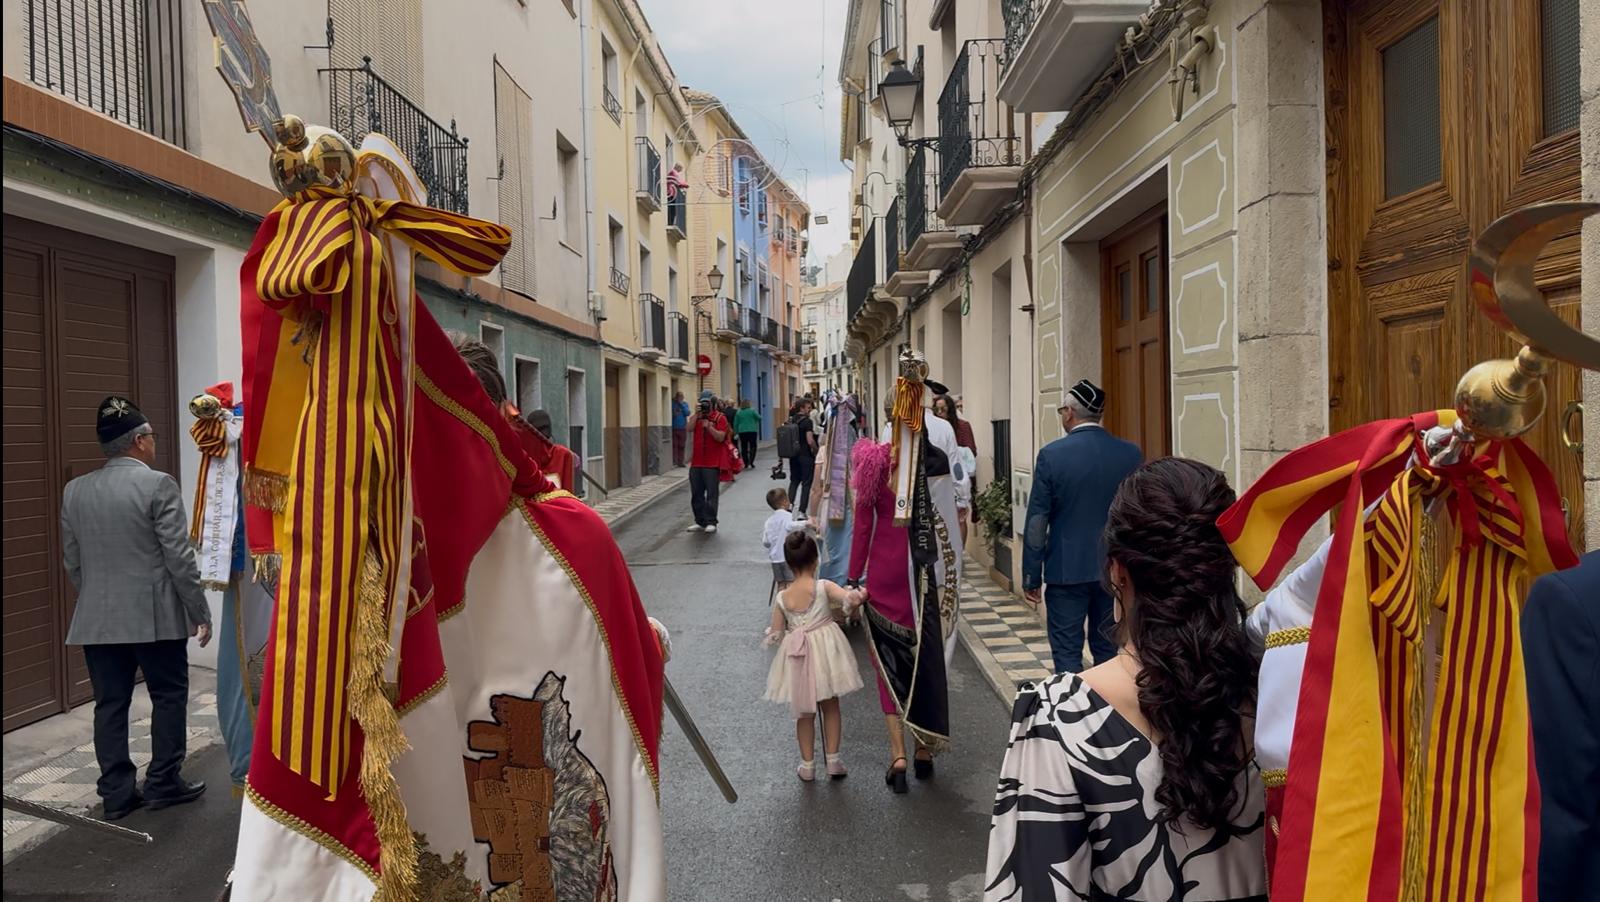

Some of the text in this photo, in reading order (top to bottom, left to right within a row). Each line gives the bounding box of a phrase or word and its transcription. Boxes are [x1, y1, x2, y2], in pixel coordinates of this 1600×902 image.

[214, 487, 223, 498] DE
[210, 502, 222, 552] COMPARSA
[209, 555, 218, 568] LA
